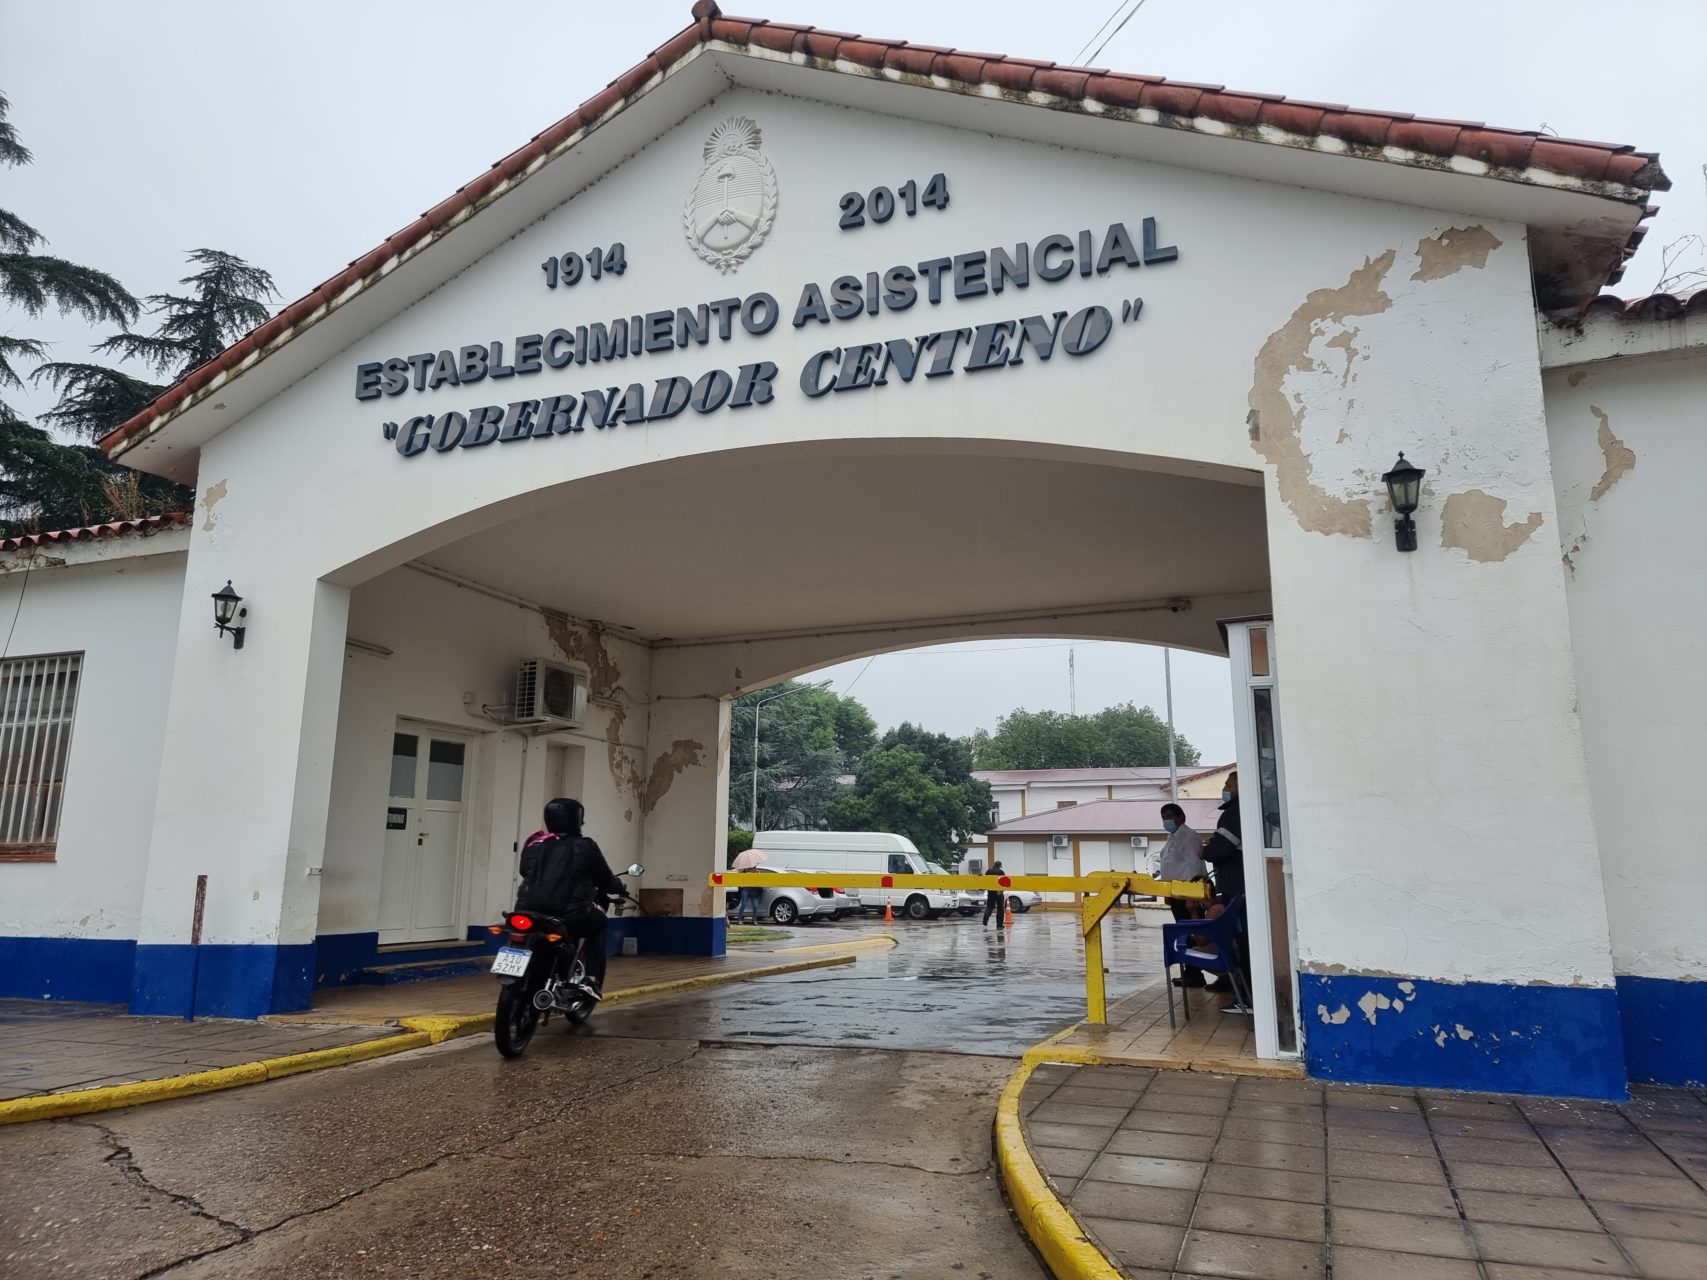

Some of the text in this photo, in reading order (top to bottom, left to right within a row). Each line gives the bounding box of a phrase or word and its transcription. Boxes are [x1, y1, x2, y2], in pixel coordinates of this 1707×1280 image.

[839, 173, 949, 230] 2014
[355, 216, 1178, 400] ESTABLECIMIENTO ASISTENCIAL
[541, 242, 627, 289] 1914
[382, 297, 1143, 457] "GOBERNADOR CENTENO"
